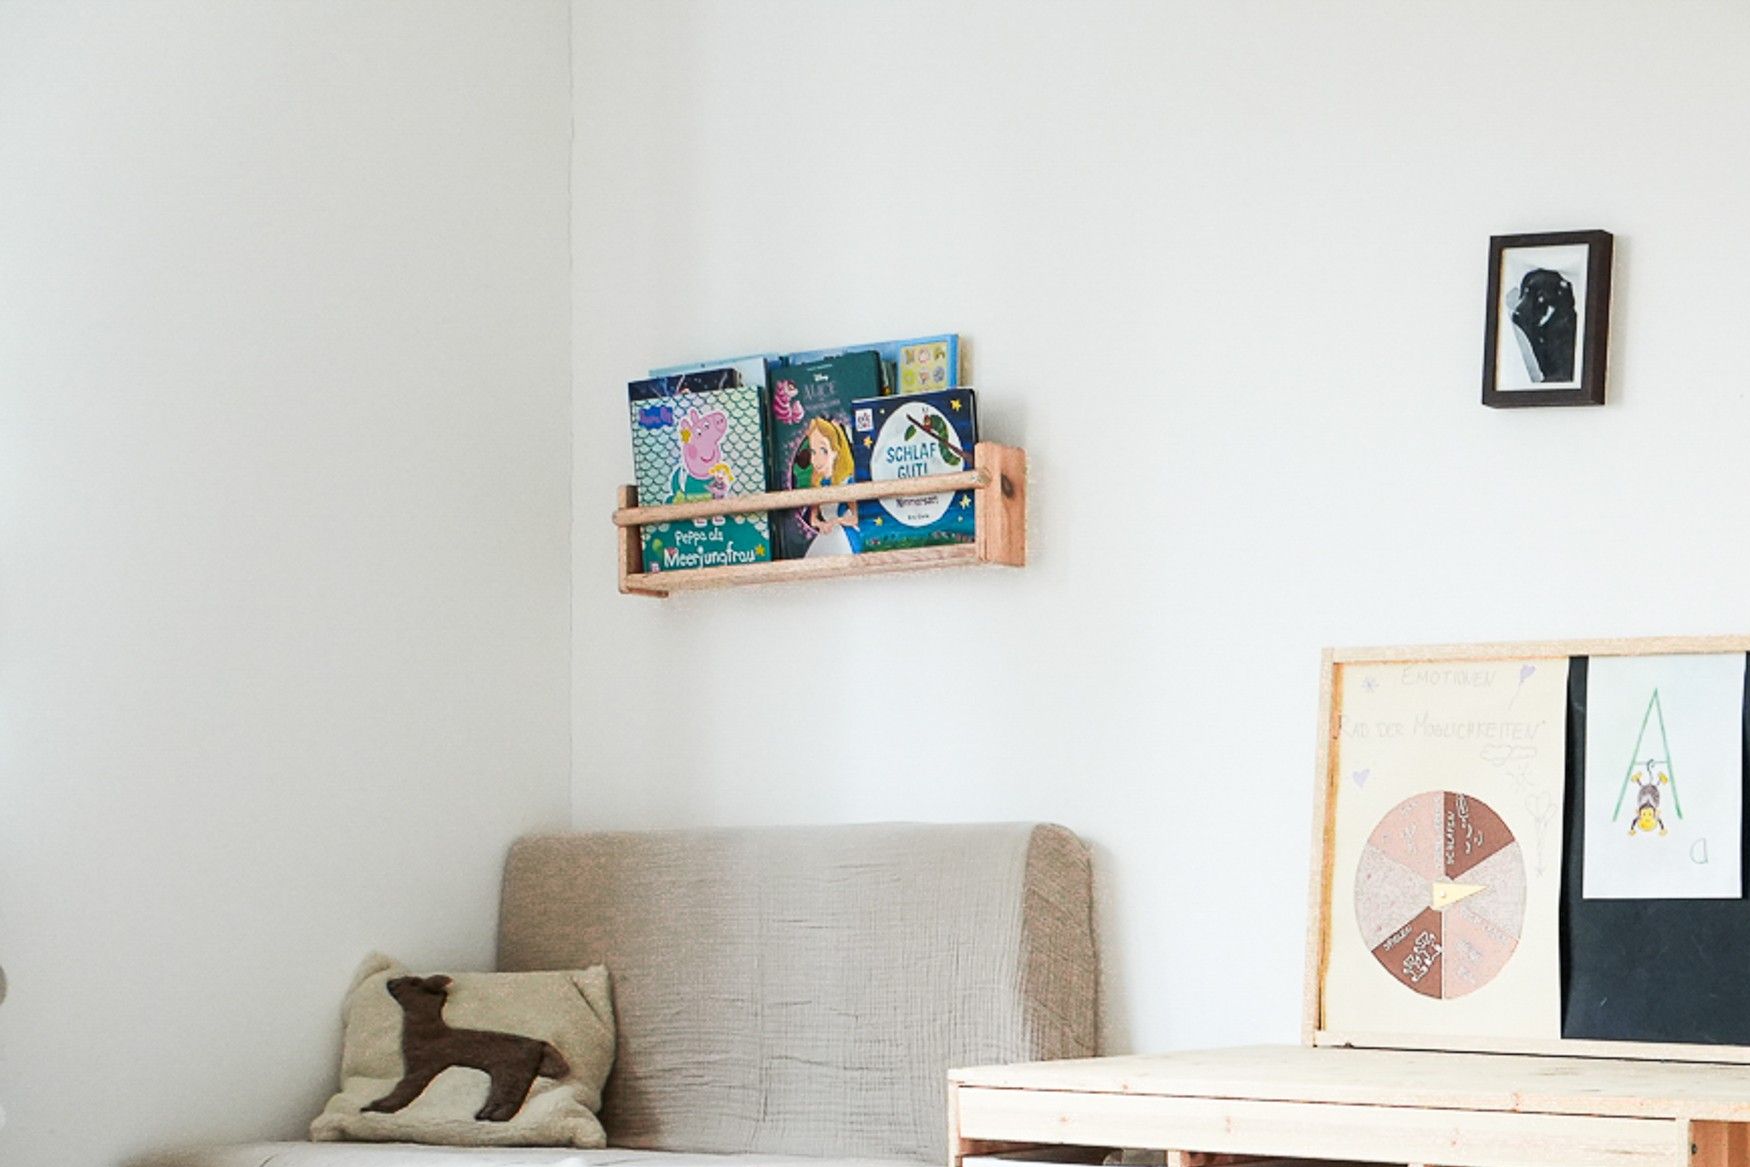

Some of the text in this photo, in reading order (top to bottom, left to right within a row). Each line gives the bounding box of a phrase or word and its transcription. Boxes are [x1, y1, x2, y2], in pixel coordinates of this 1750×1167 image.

[886, 442, 936, 464] SCHLAF
[897, 462, 928, 480] GUT!
[664, 541, 756, 568] Meerjungfrau
